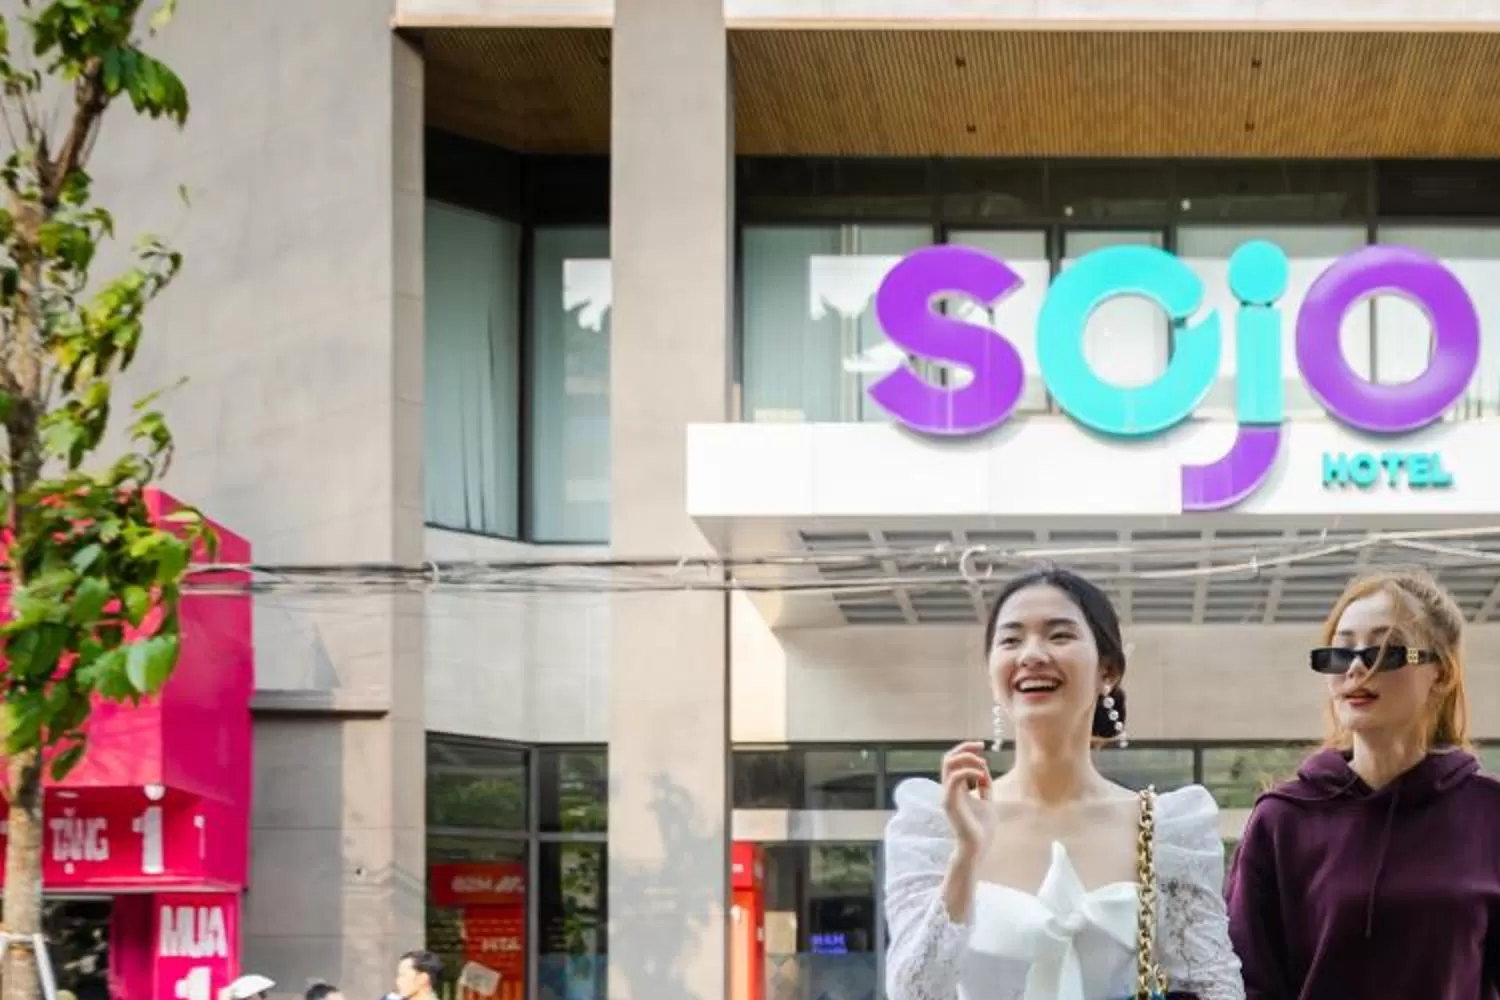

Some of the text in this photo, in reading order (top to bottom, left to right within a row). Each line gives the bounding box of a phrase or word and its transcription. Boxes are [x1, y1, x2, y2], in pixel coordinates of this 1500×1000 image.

[1322, 451, 1454, 488] HOTEL
[132, 806, 164, 875] 1
[160, 904, 228, 957] MUA
